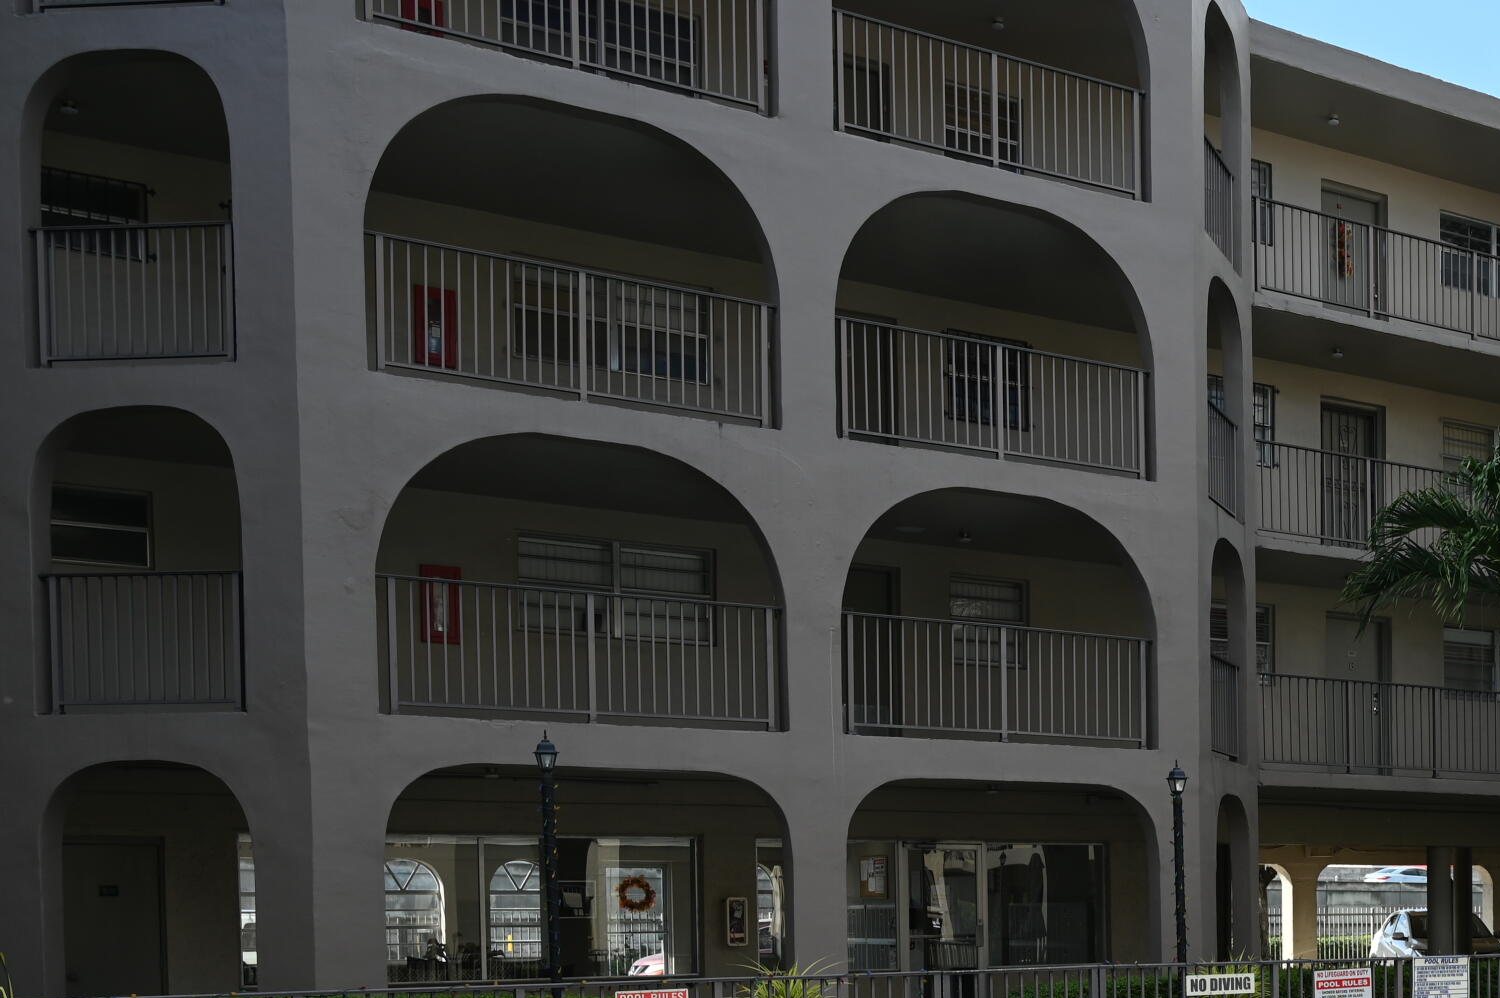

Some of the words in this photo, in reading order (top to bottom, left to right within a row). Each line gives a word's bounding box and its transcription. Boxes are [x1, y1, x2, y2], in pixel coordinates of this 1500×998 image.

[1190, 978, 1207, 992] NO
[1210, 976, 1251, 991] DIVING
[1342, 979, 1368, 987] RULES
